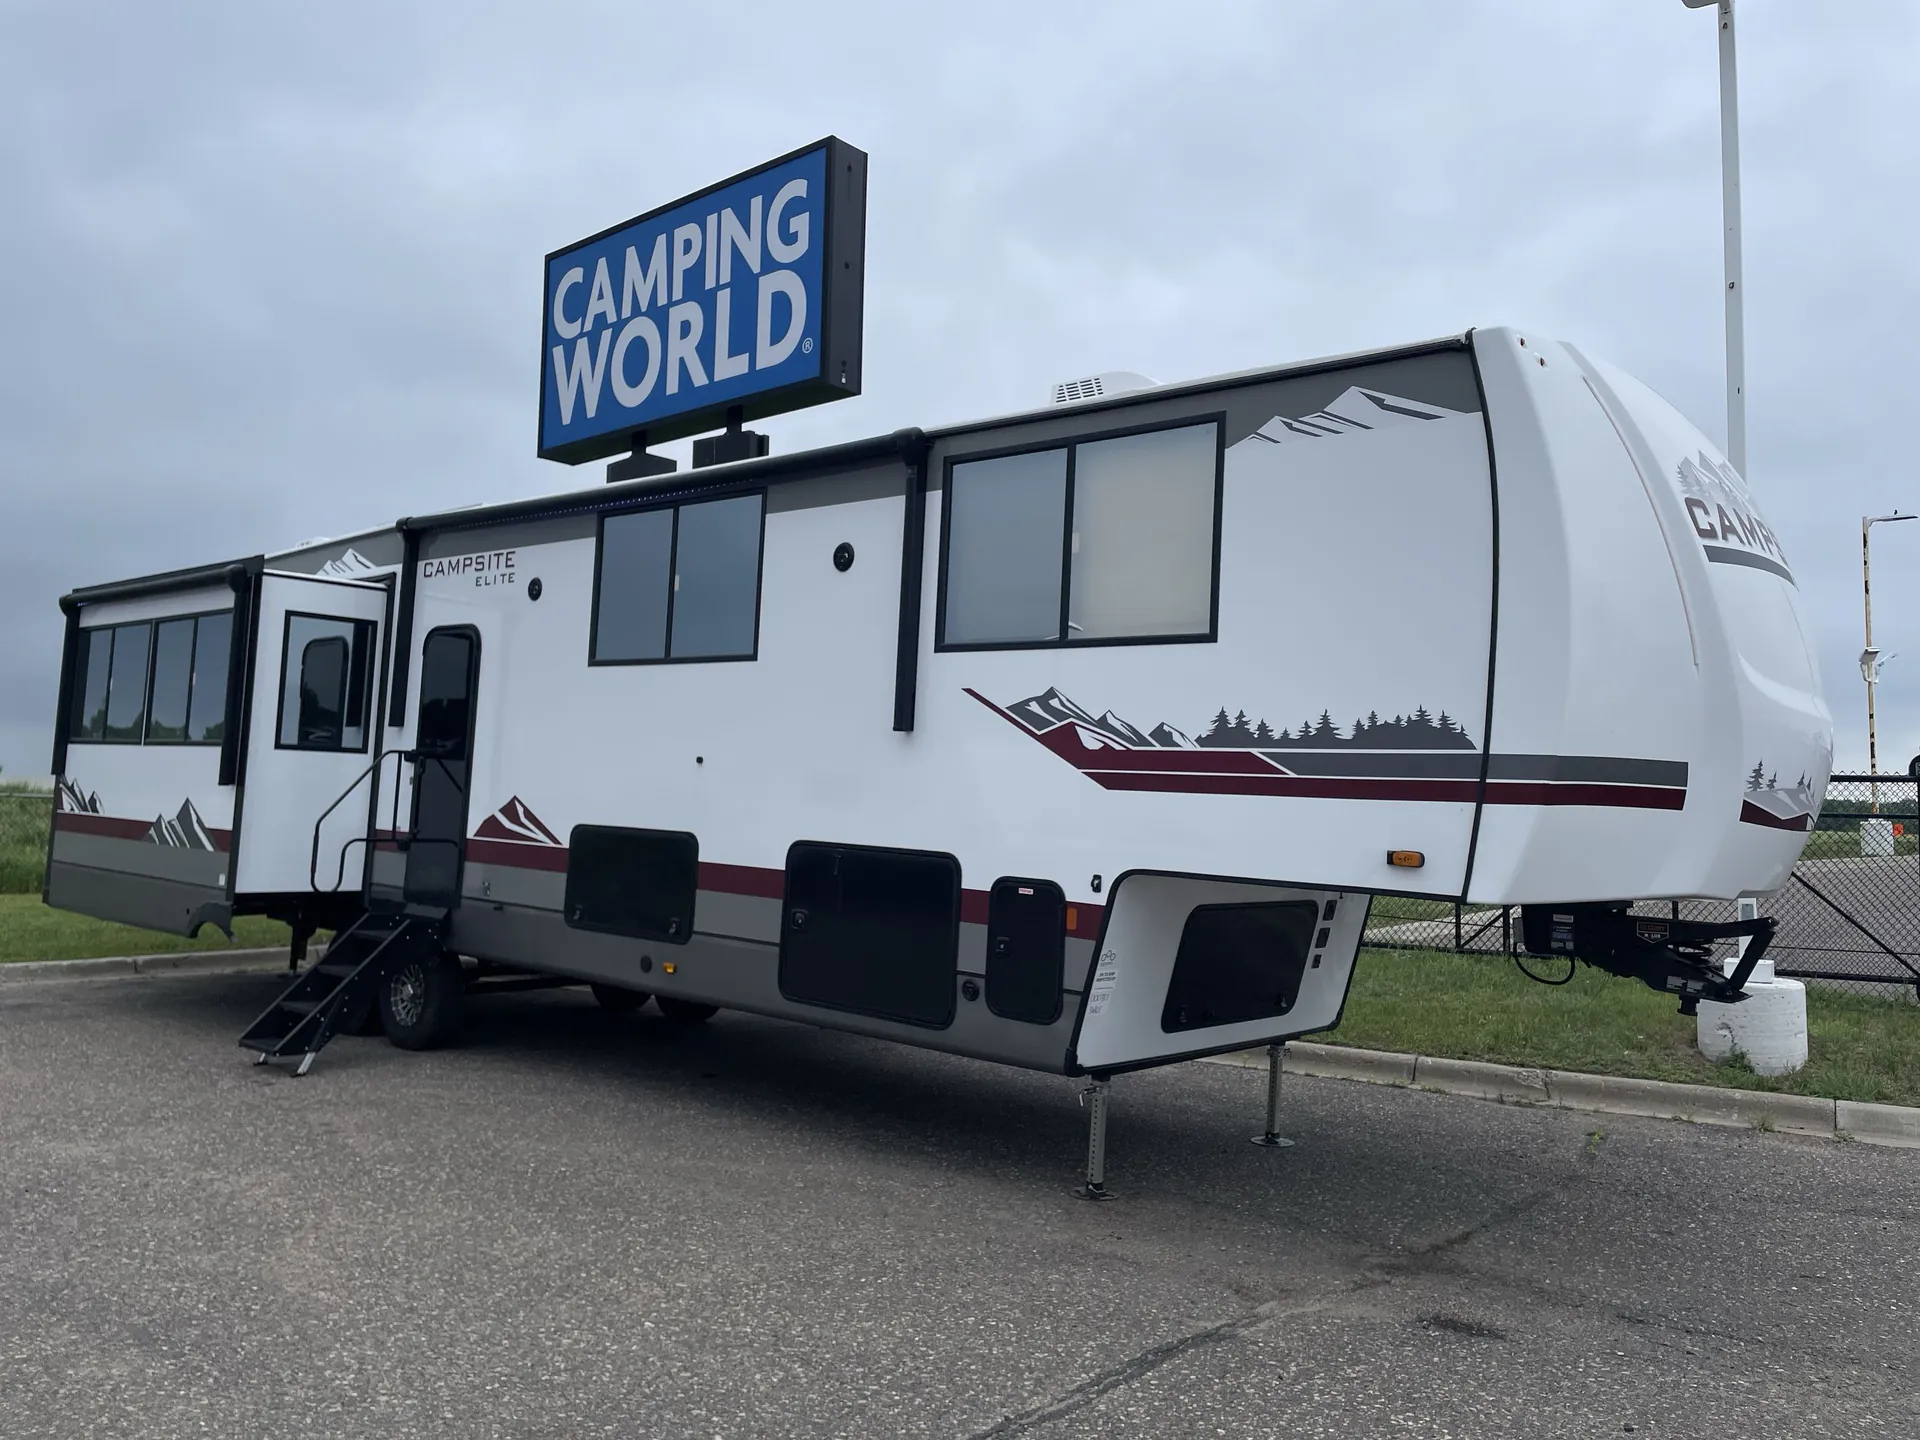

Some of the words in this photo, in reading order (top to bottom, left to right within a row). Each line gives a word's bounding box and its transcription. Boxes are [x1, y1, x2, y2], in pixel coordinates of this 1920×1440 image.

[553, 178, 810, 339] CAMPING
[423, 551, 516, 578] CAMPSITE
[475, 572, 516, 587] ELITE
